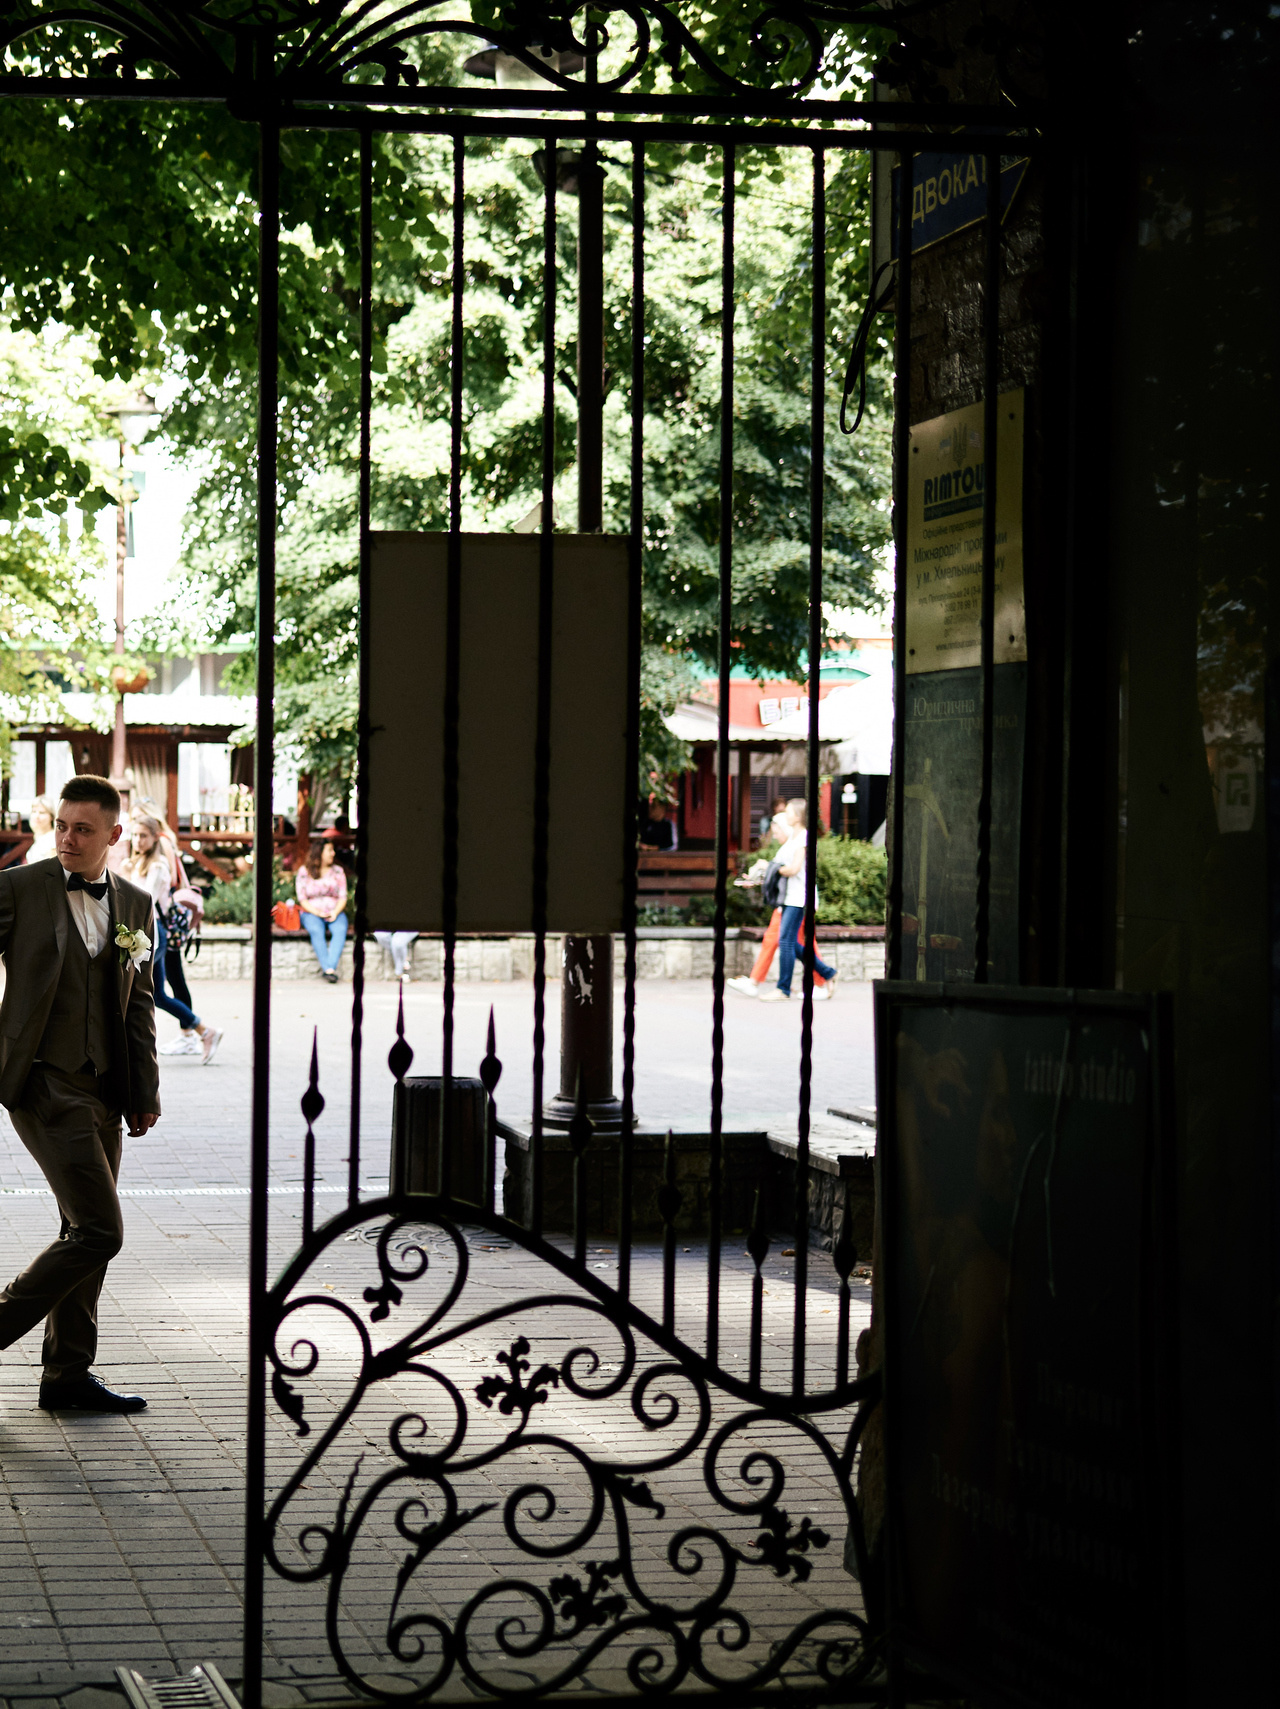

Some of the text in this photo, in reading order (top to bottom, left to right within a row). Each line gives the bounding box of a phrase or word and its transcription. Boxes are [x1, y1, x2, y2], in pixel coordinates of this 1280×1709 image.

[896, 153, 988, 228] ДВОКАТ
[924, 463, 986, 505] RIMTOU
[959, 714, 1018, 736] праика
